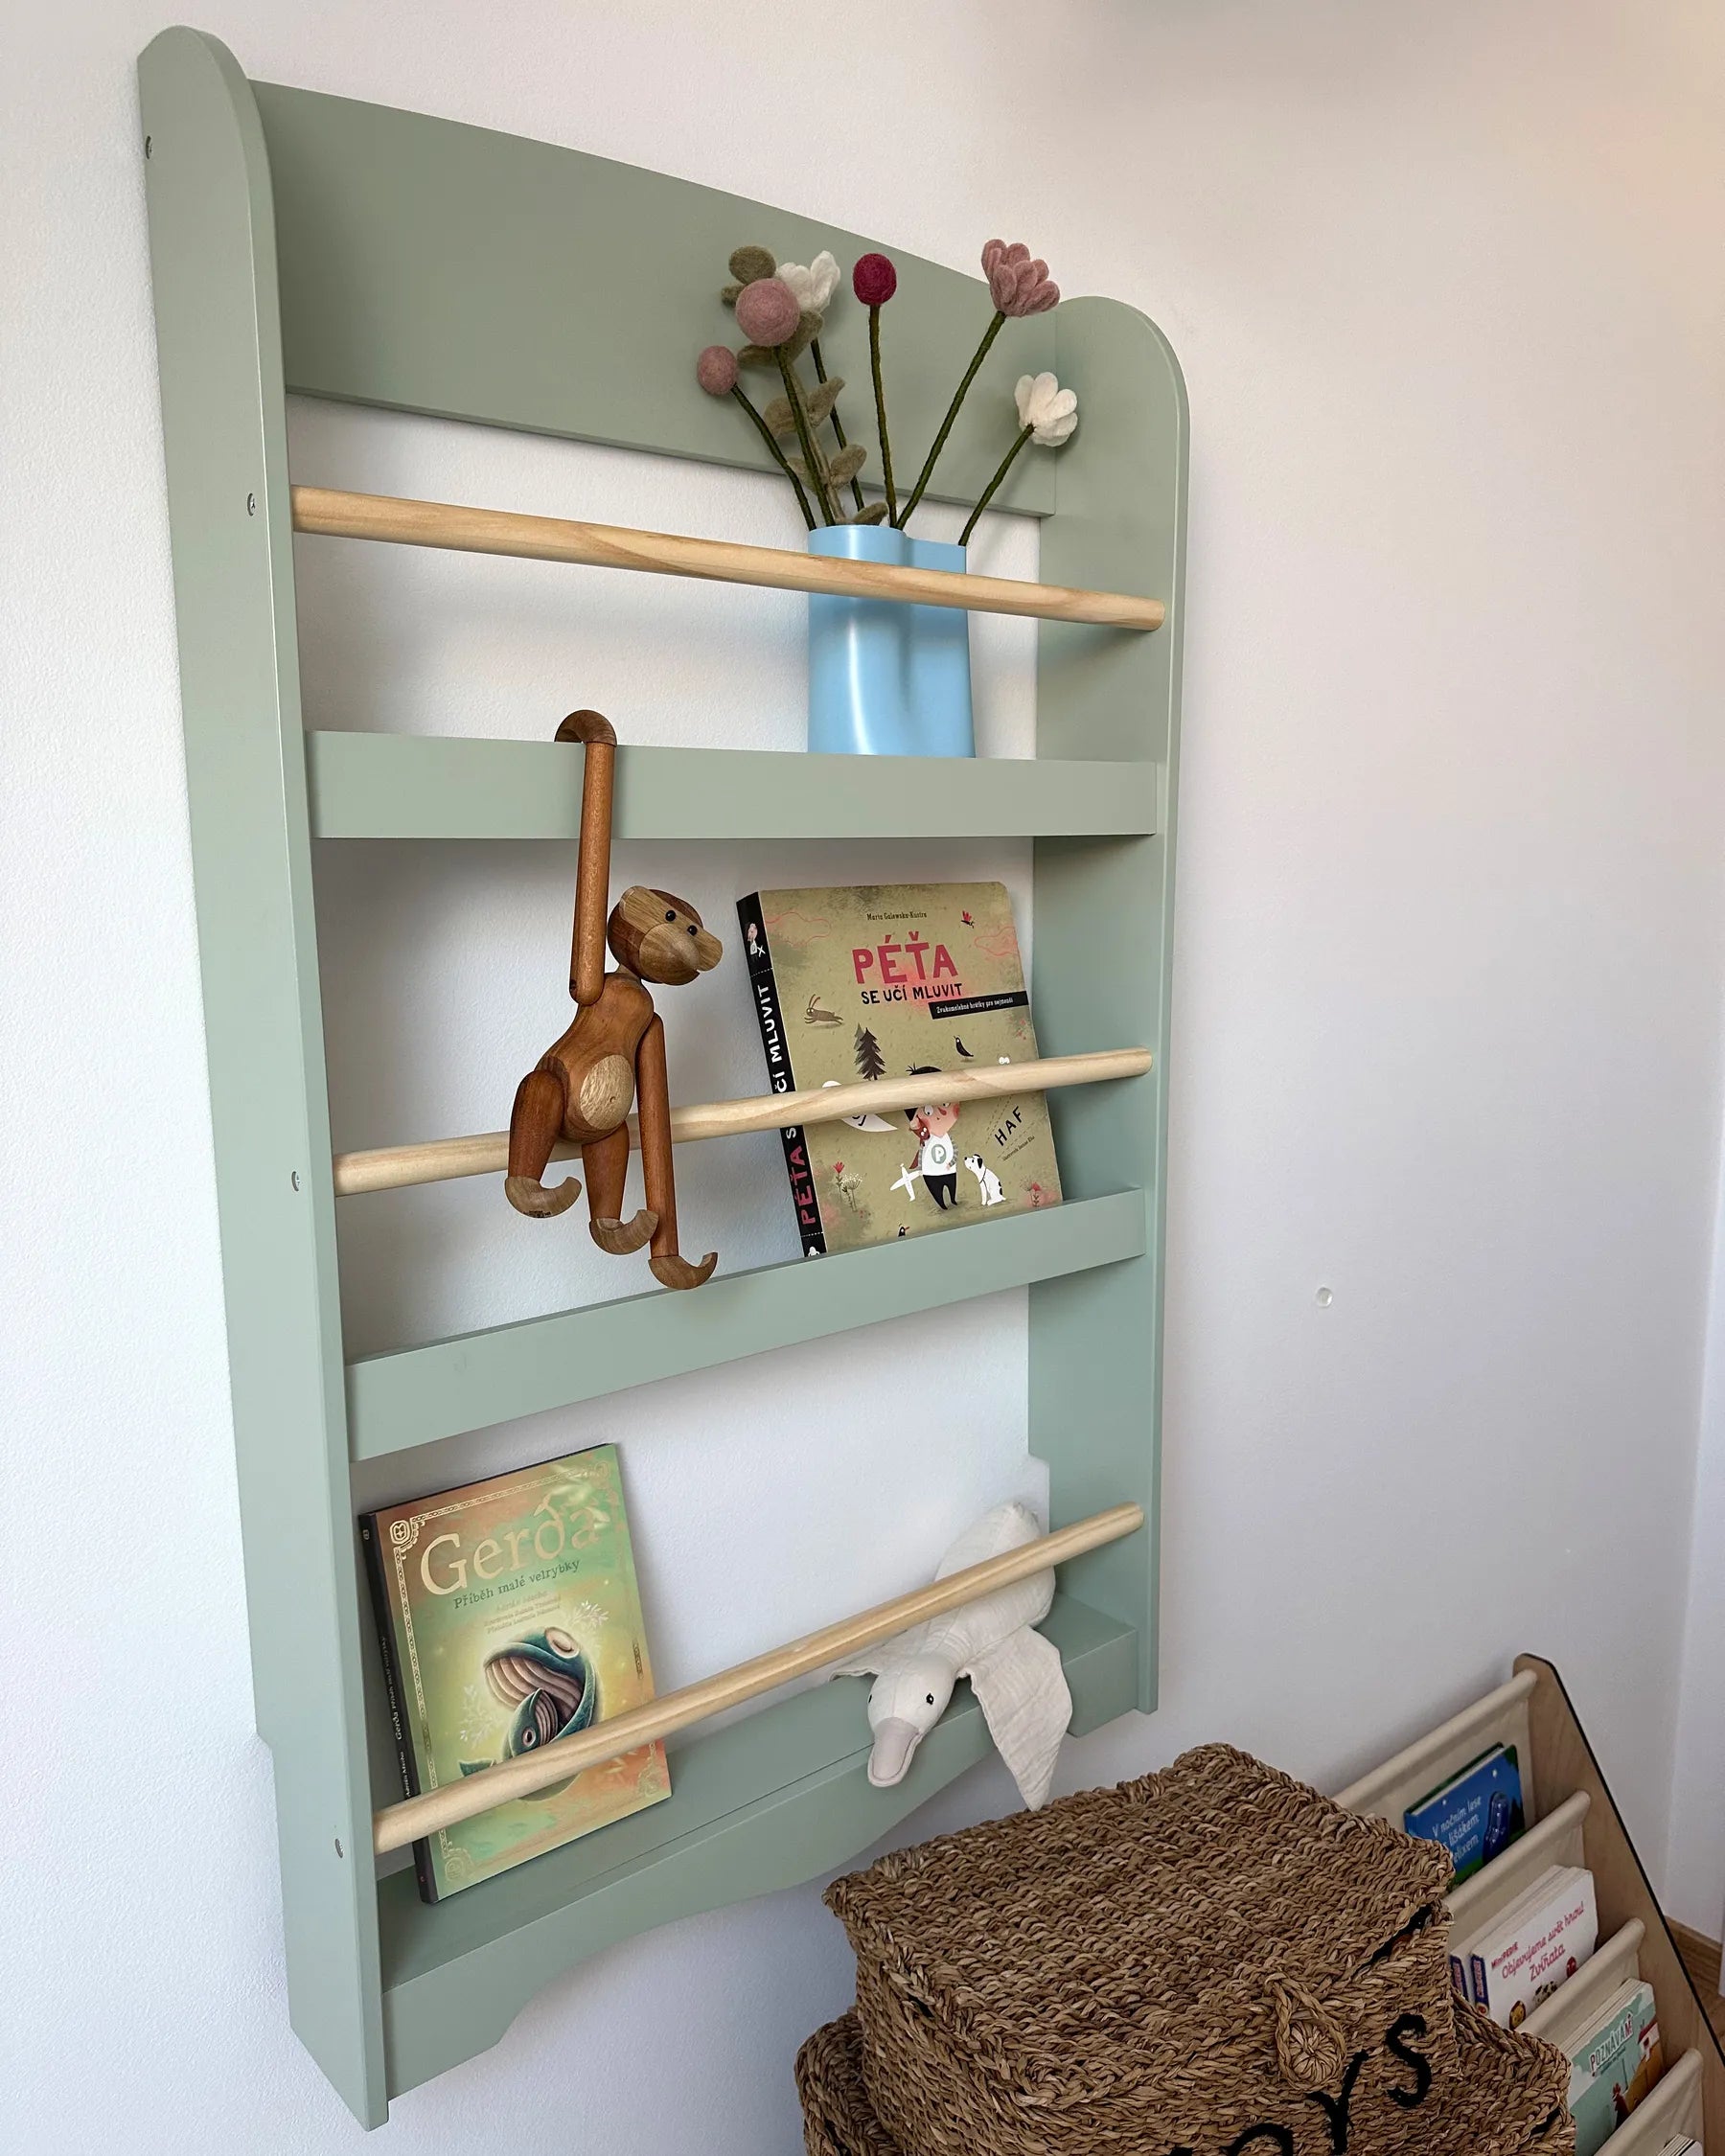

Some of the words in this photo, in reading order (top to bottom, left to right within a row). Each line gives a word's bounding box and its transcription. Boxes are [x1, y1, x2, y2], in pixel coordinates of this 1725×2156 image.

[852, 930, 958, 984] PÉŤA
[861, 990, 881, 1004] SE
[884, 983, 908, 1002] UČÍ
[912, 983, 963, 1000] MLUVIT
[758, 984, 782, 1063] MLUVIT
[772, 1071, 788, 1093] ČÍ
[786, 1127, 796, 1139] S
[994, 1106, 1023, 1146] HAF
[935, 1149, 945, 1162] P
[790, 1145, 816, 1225] PÉŤA
[453, 1587, 494, 1610] Příběh
[498, 1576, 526, 1595] malé
[529, 1559, 581, 1583] velrybky
